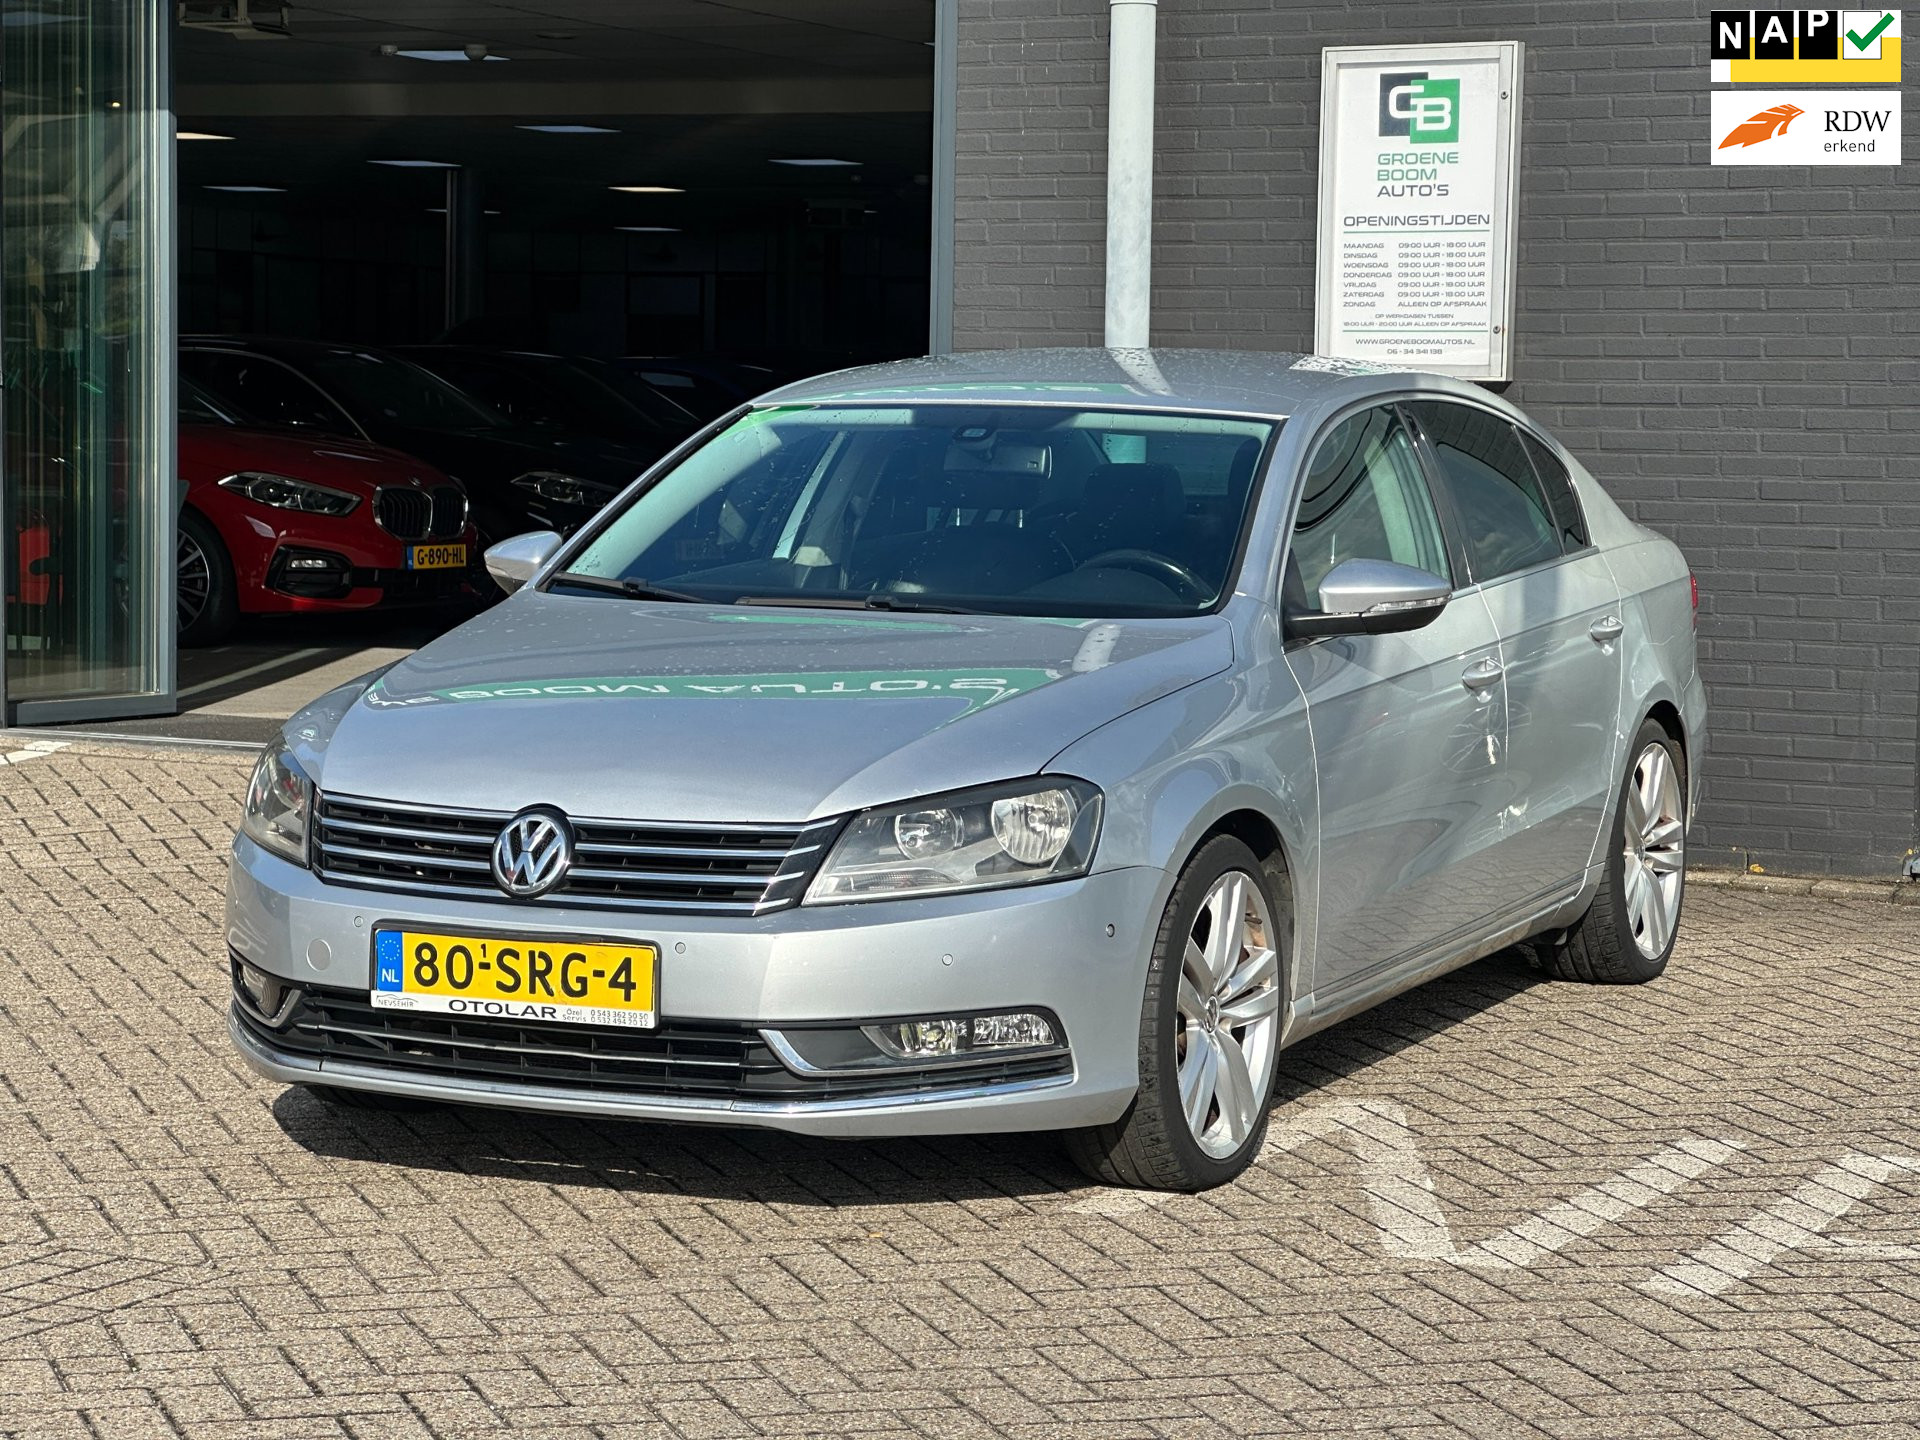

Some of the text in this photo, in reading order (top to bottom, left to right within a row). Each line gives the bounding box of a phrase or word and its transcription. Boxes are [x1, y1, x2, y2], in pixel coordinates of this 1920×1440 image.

[1377, 152, 1459, 166] GROENE
[1377, 168, 1437, 182] BOOM
[1377, 184, 1449, 198] AUTO'S
[1343, 214, 1491, 227] OPENINGSTIJDEN
[417, 547, 464, 565] G-890-HL
[381, 968, 399, 983] NL
[448, 999, 557, 1019] OTOLAR
